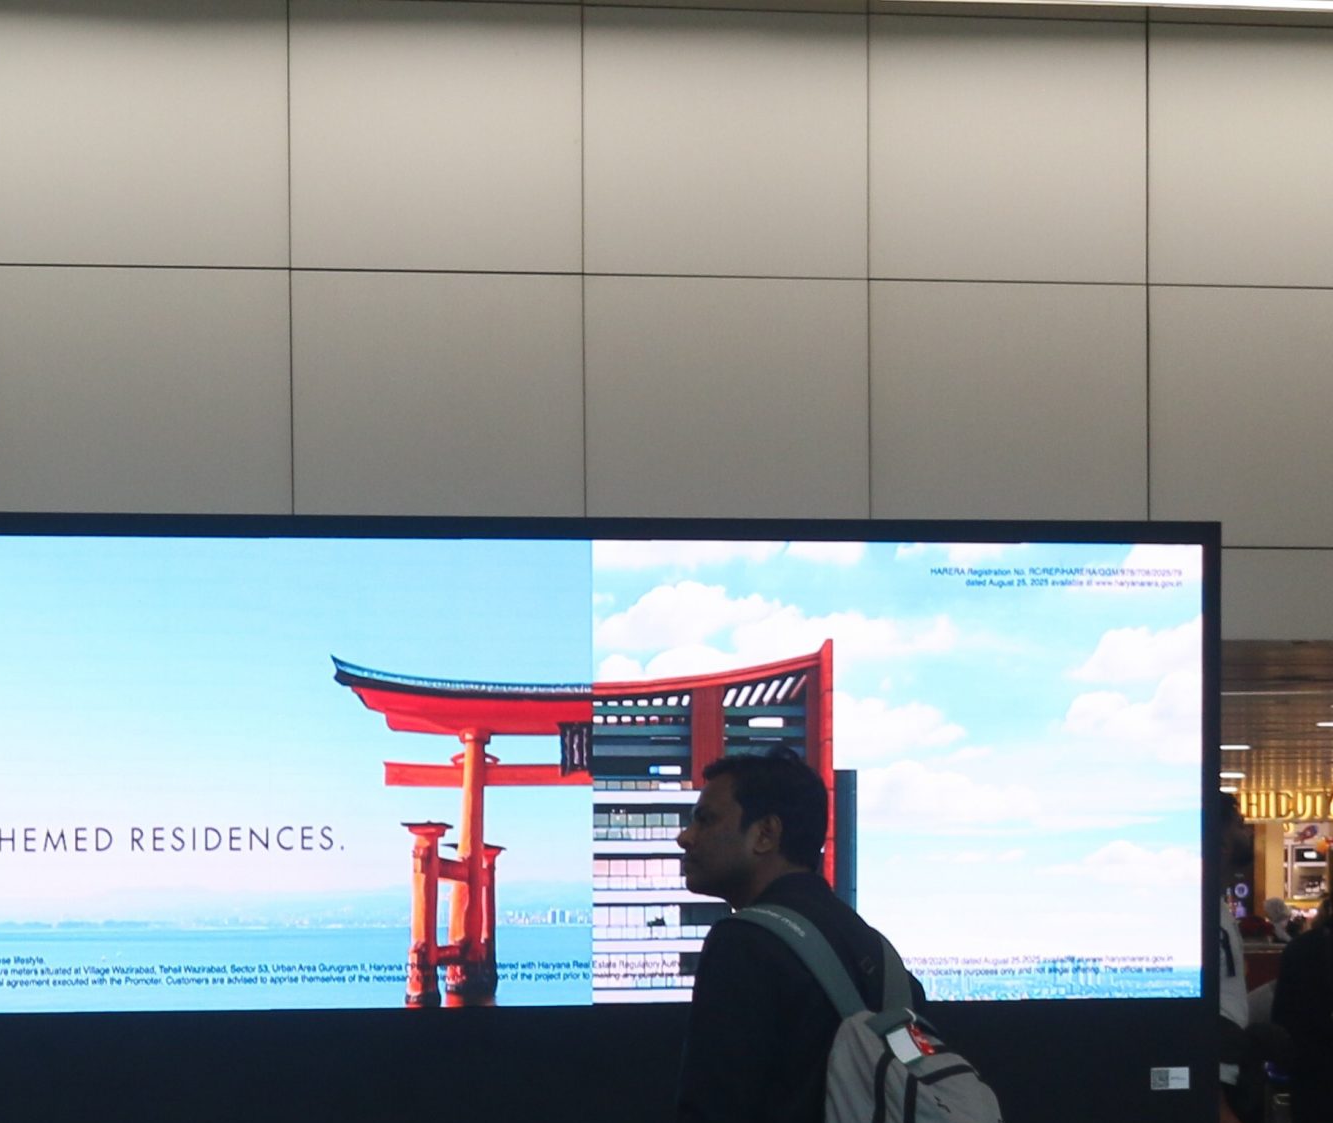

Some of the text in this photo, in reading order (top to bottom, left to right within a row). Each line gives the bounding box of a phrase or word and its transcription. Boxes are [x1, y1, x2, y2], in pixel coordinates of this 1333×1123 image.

[131, 825, 346, 852] RESIDENCES.
[41, 967, 73, 976] situated
[84, 966, 110, 976] Village
[230, 965, 256, 974] Sector
[272, 964, 297, 973] Urban
[298, 964, 317, 973] Area
[319, 963, 359, 974] Gurugram
[369, 963, 403, 975] Haryana
[538, 960, 571, 971] Haryana
[573, 959, 590, 968] Real
[7, 977, 50, 988] agreement
[52, 976, 89, 986] executed
[166, 975, 210, 985] Customers
[227, 974, 258, 984] advised
[270, 975, 298, 985] apprise
[301, 974, 346, 983] themselves
